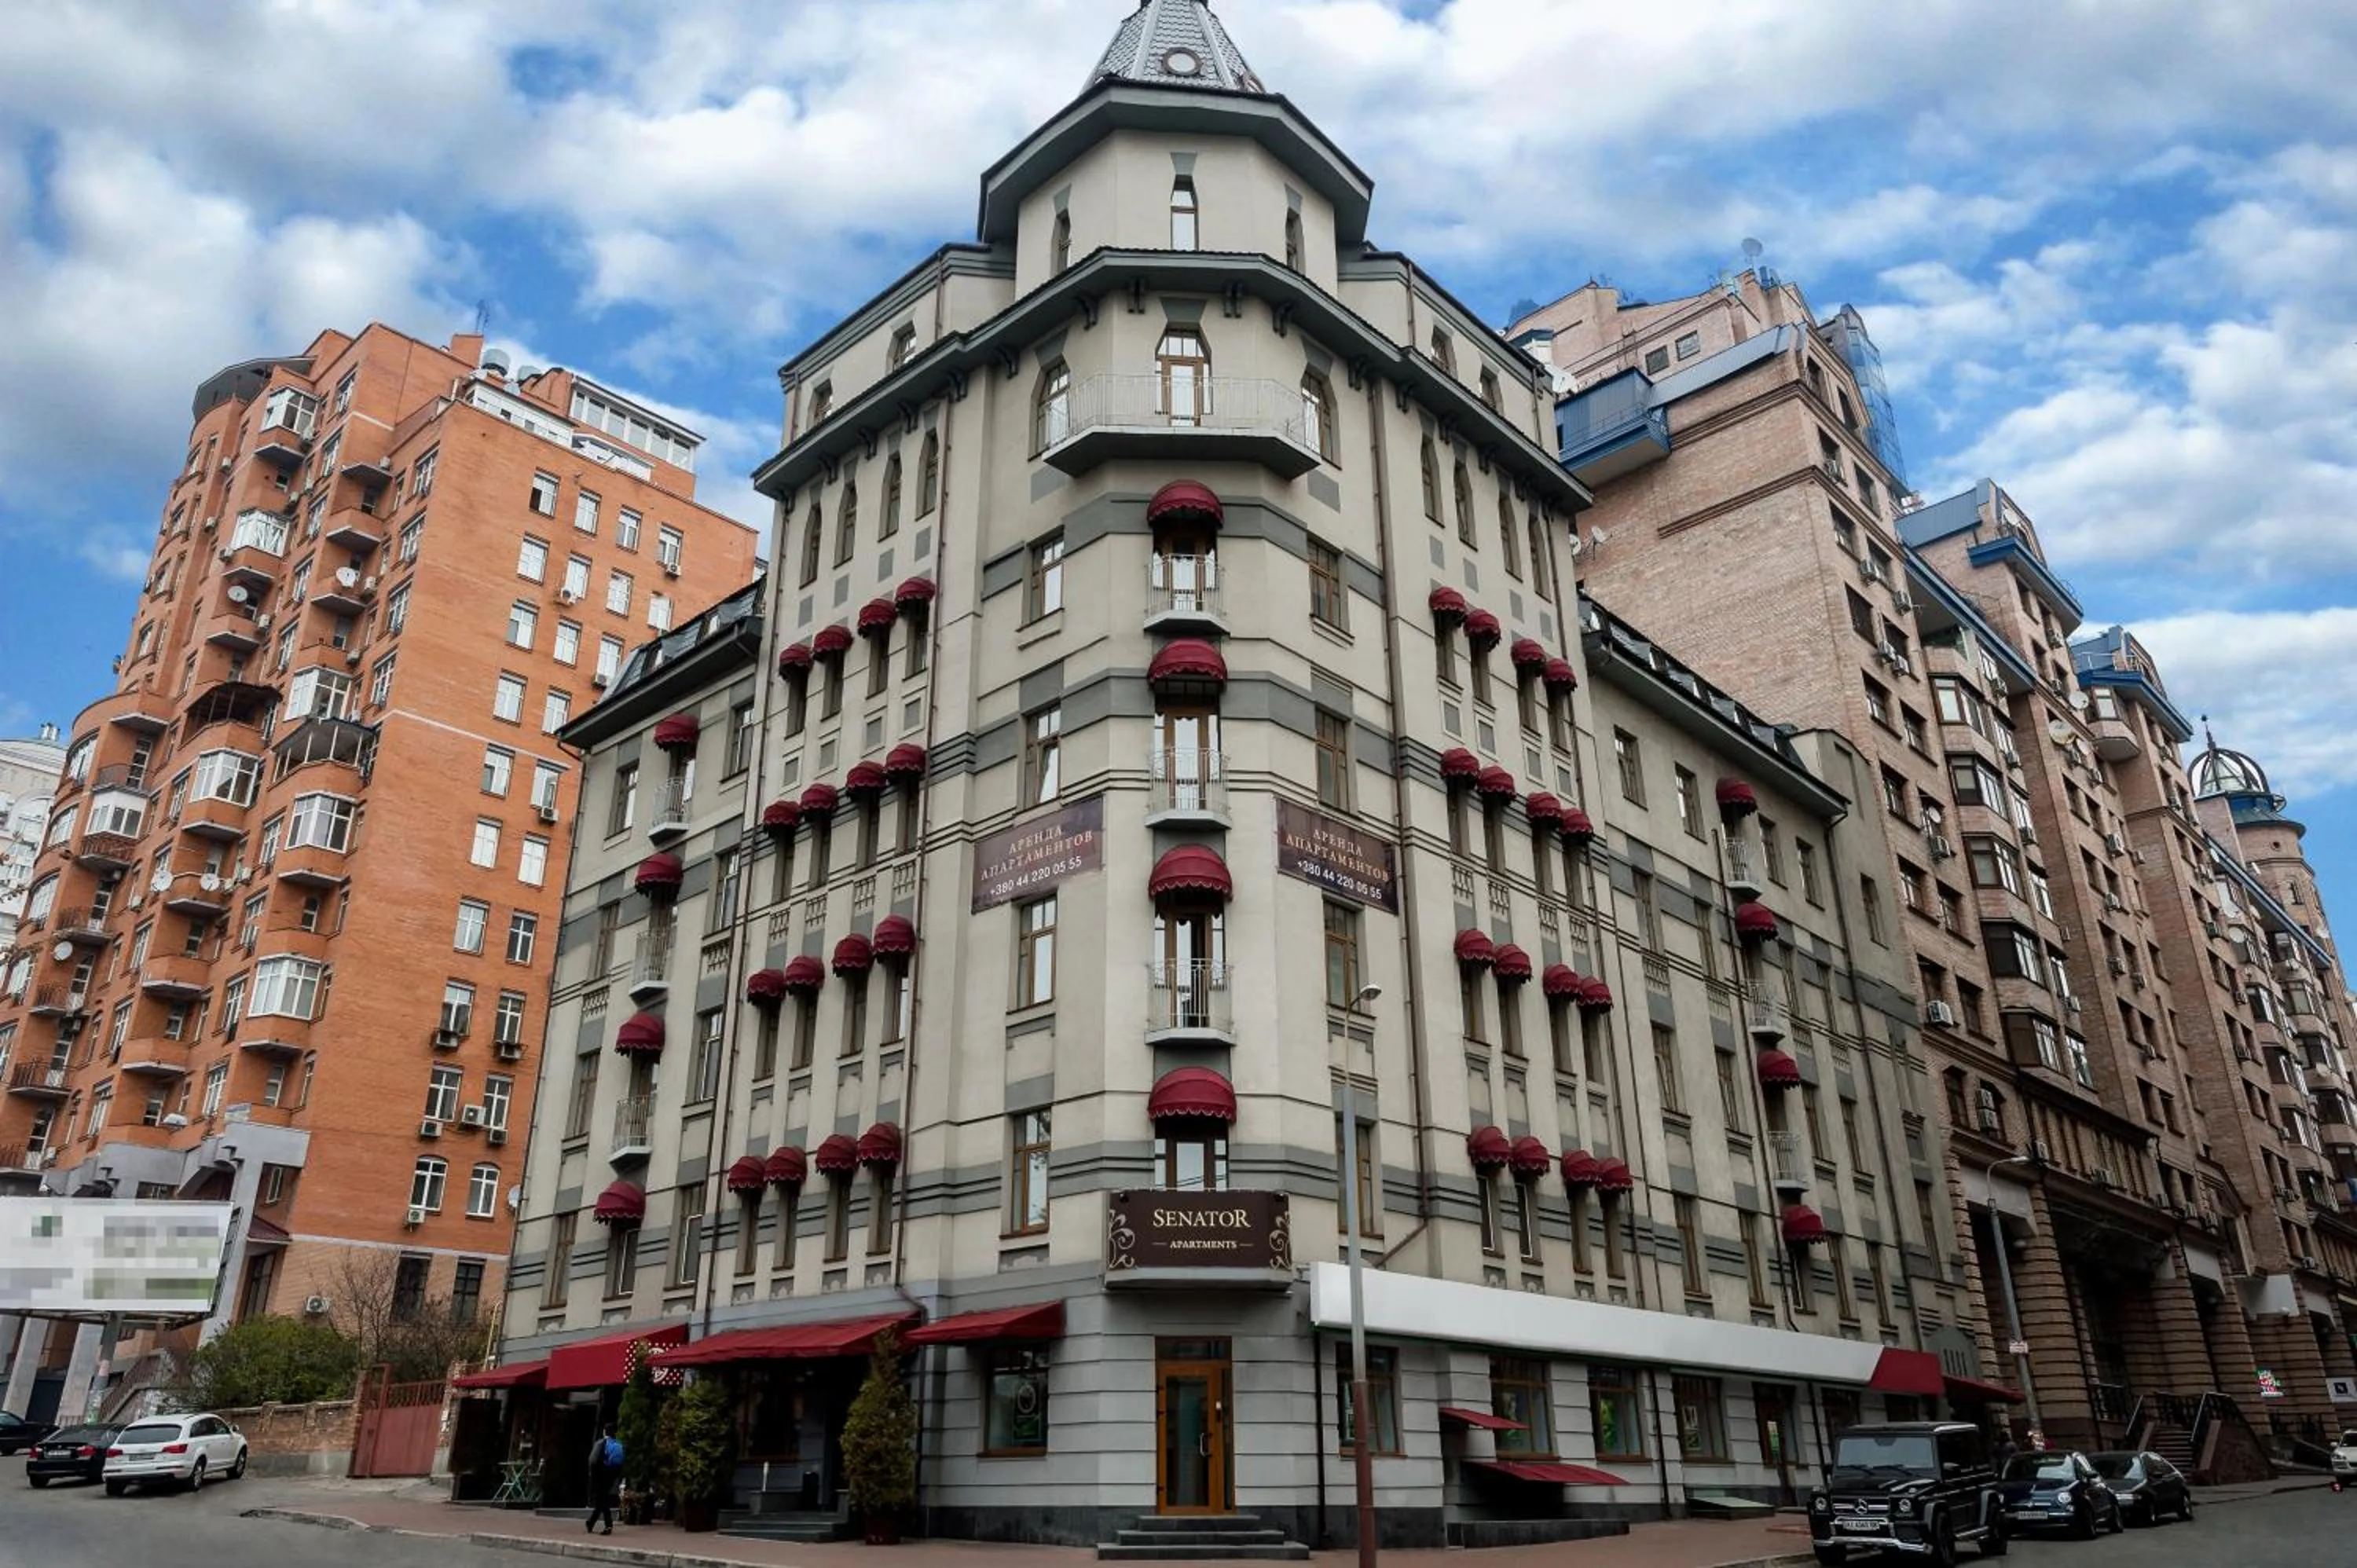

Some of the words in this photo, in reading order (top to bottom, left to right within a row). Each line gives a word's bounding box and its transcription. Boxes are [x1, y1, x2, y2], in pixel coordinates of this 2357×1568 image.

[981, 830, 1093, 880] АПАРТАМЕНТОВ
[1009, 825, 1062, 854] АРЕНДА
[1313, 829, 1362, 856] АРЕНДА
[1286, 833, 1388, 882] АПАРТАМЕНТОВ
[990, 879, 1014, 896] +380
[1016, 874, 1028, 887] 44
[1032, 866, 1050, 883] 220
[1053, 861, 1065, 874] 05
[1069, 855, 1082, 870] 55
[1298, 860, 1321, 876] +380
[1322, 869, 1335, 881] 44
[1336, 874, 1354, 890] 220
[1357, 882, 1369, 895] 05
[1370, 887, 1382, 899] 55
[1153, 1209, 1251, 1228] SENATOR
[1170, 1240, 1237, 1249] APARTMENTS
